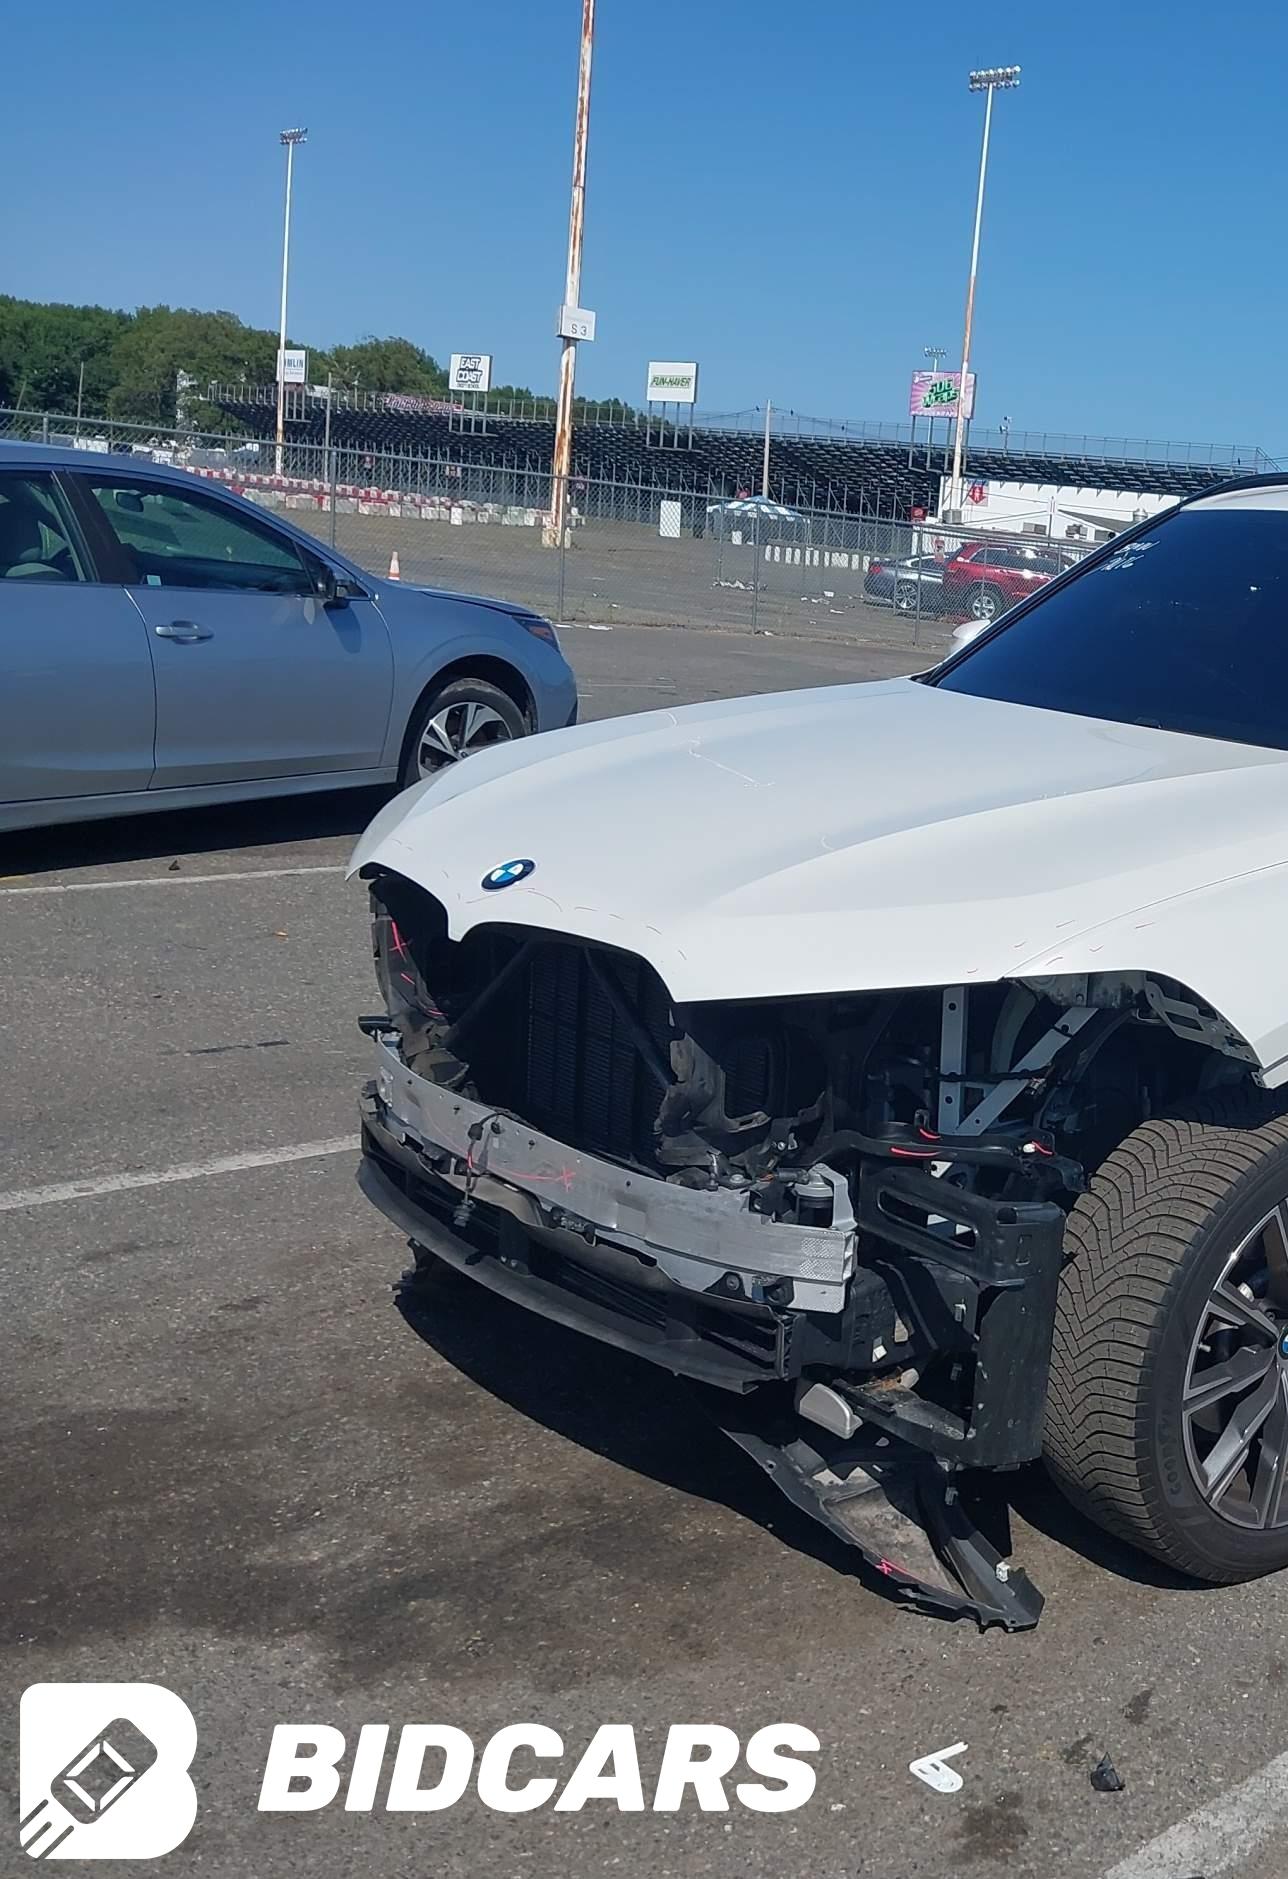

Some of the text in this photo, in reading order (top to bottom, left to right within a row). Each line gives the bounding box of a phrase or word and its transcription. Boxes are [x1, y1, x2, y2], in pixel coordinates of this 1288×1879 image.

[570, 322, 588, 337] S 3
[460, 356, 482, 370] EAST
[456, 369, 484, 384] COAST
